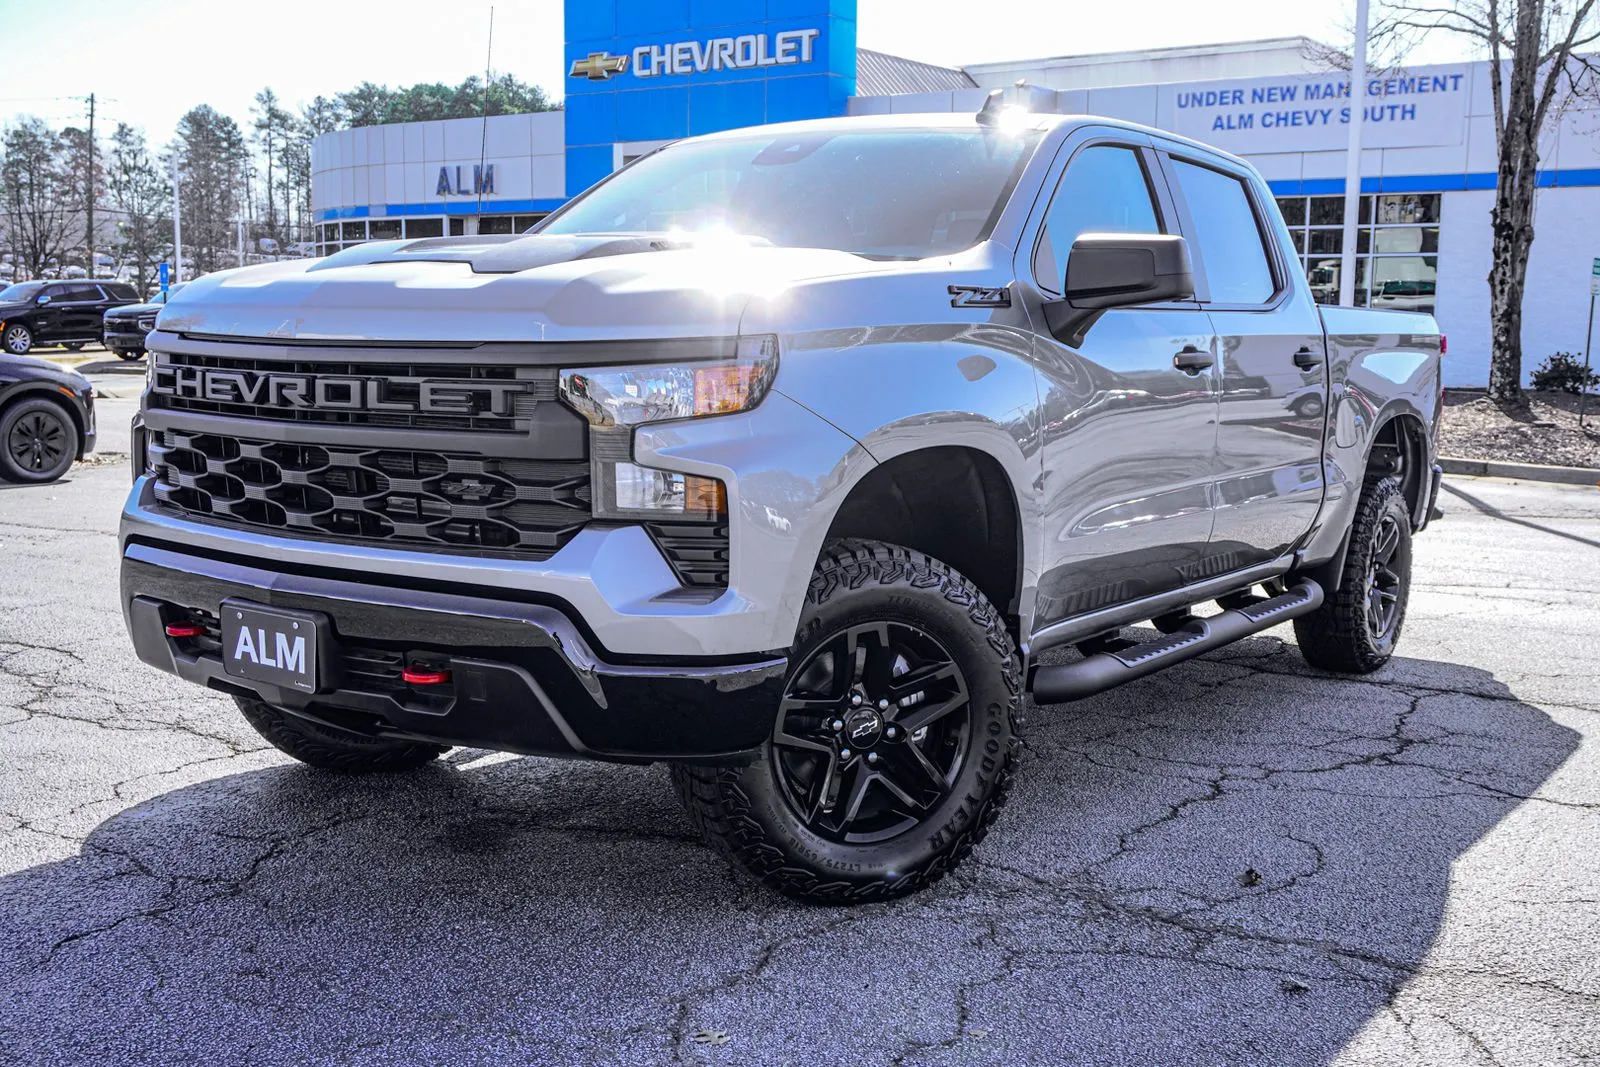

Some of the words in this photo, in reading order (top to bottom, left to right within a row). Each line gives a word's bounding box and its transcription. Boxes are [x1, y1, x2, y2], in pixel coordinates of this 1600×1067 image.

[632, 29, 819, 77] CHEVROLET
[1177, 89, 1244, 108] UNDER
[1251, 85, 1297, 104] NEW
[1304, 74, 1463, 102] MANGEMENT
[1212, 113, 1253, 131] ALM
[1261, 108, 1333, 128] CHEVY
[1340, 104, 1416, 123] SUTH
[436, 164, 494, 195] ALM
[152, 367, 530, 415] CHEVROLET
[234, 625, 306, 674] ALM
[926, 702, 1001, 851] GOODYEAR
